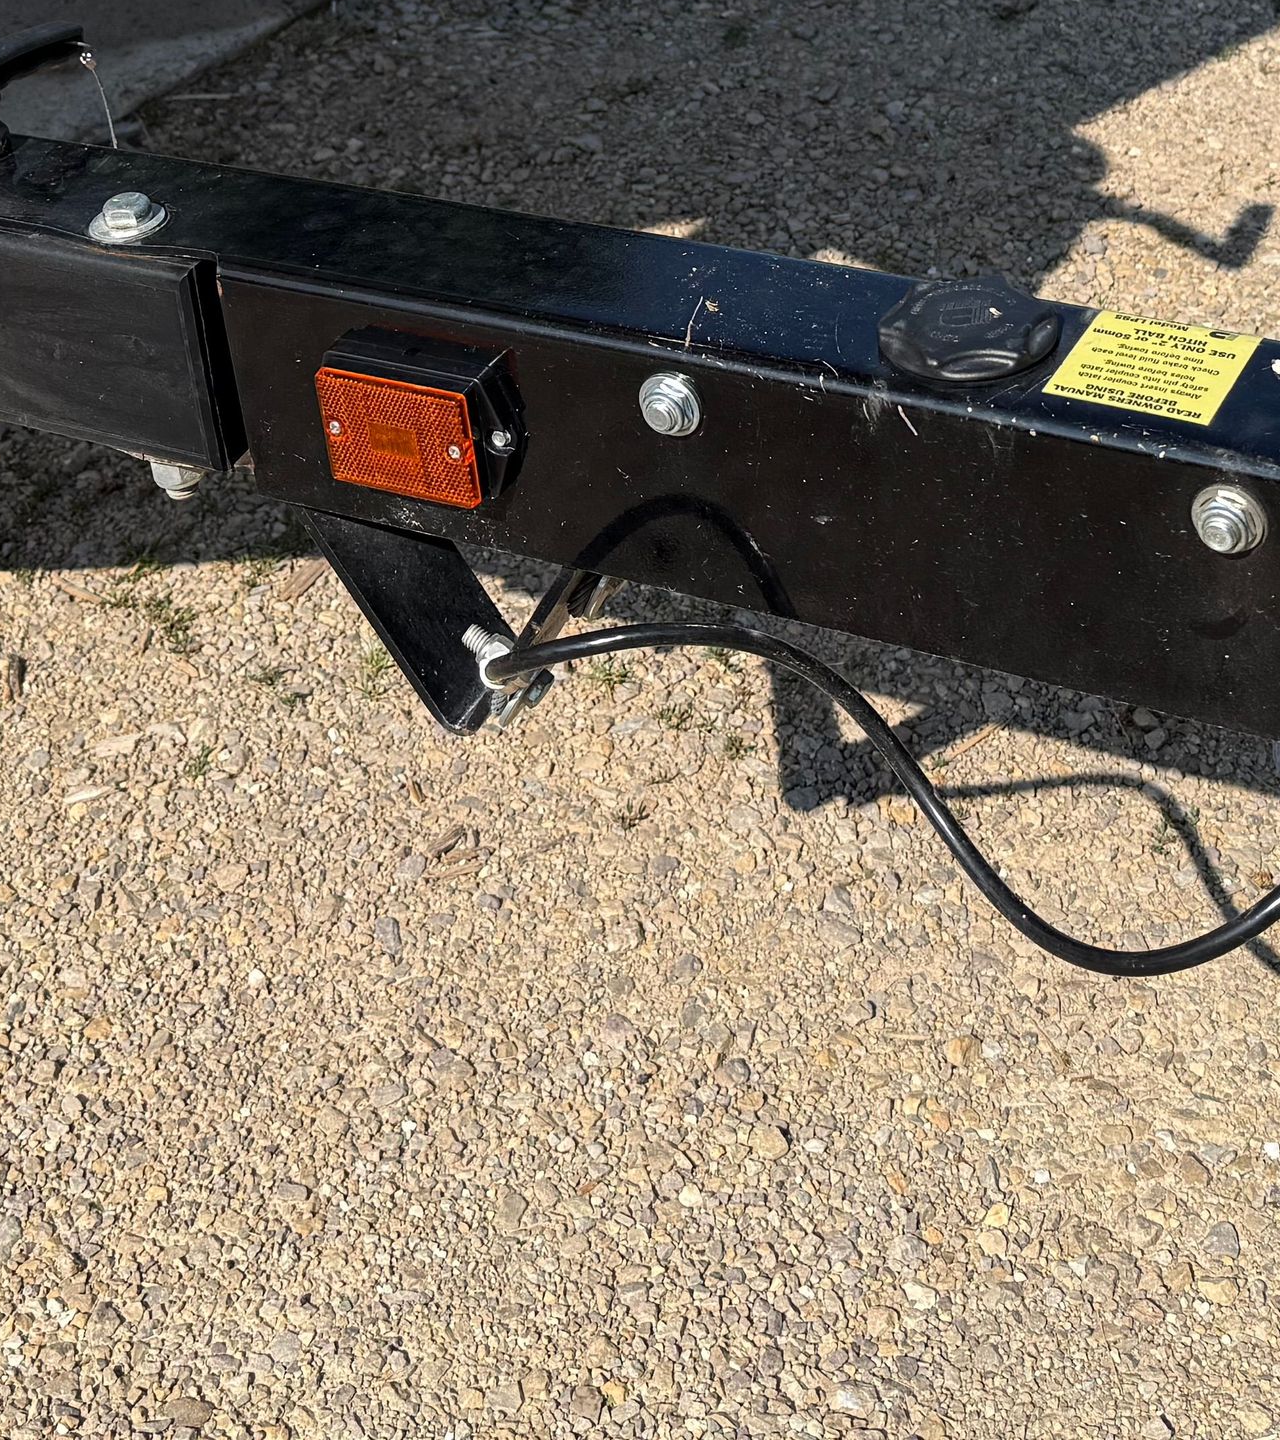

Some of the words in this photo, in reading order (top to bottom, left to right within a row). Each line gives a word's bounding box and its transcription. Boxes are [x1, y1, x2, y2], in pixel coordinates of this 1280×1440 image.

[1149, 320, 1189, 332] Model
[1092, 327, 1132, 340] 50mm
[1133, 328, 1166, 339] BALL
[1167, 334, 1208, 347] HITCH
[1091, 347, 1114, 355] each
[1170, 342, 1206, 354] ONLY
[1114, 351, 1137, 361] level
[1151, 350, 1181, 361] before
[1208, 349, 1237, 360] USE
[1138, 356, 1160, 365] fluid
[1162, 360, 1189, 370] brake
[1183, 356, 1204, 365] time
[1080, 363, 1104, 373] latch
[1105, 368, 1141, 379] coupler
[1137, 366, 1168, 377] before
[1191, 366, 1220, 376] Check
[1078, 371, 1102, 381] latch
[1102, 376, 1139, 387] coupler
[1142, 375, 1161, 384] into
[1170, 372, 1196, 383] holes
[1053, 383, 1105, 400] MANUAL
[1085, 383, 1125, 396] USING
[1139, 383, 1168, 394] insert
[1179, 382, 1209, 392] safety
[1127, 391, 1178, 407] BEFORE
[1170, 389, 1202, 400] Always
[1107, 395, 1163, 411] OWNERS
[1166, 407, 1202, 419] READ
